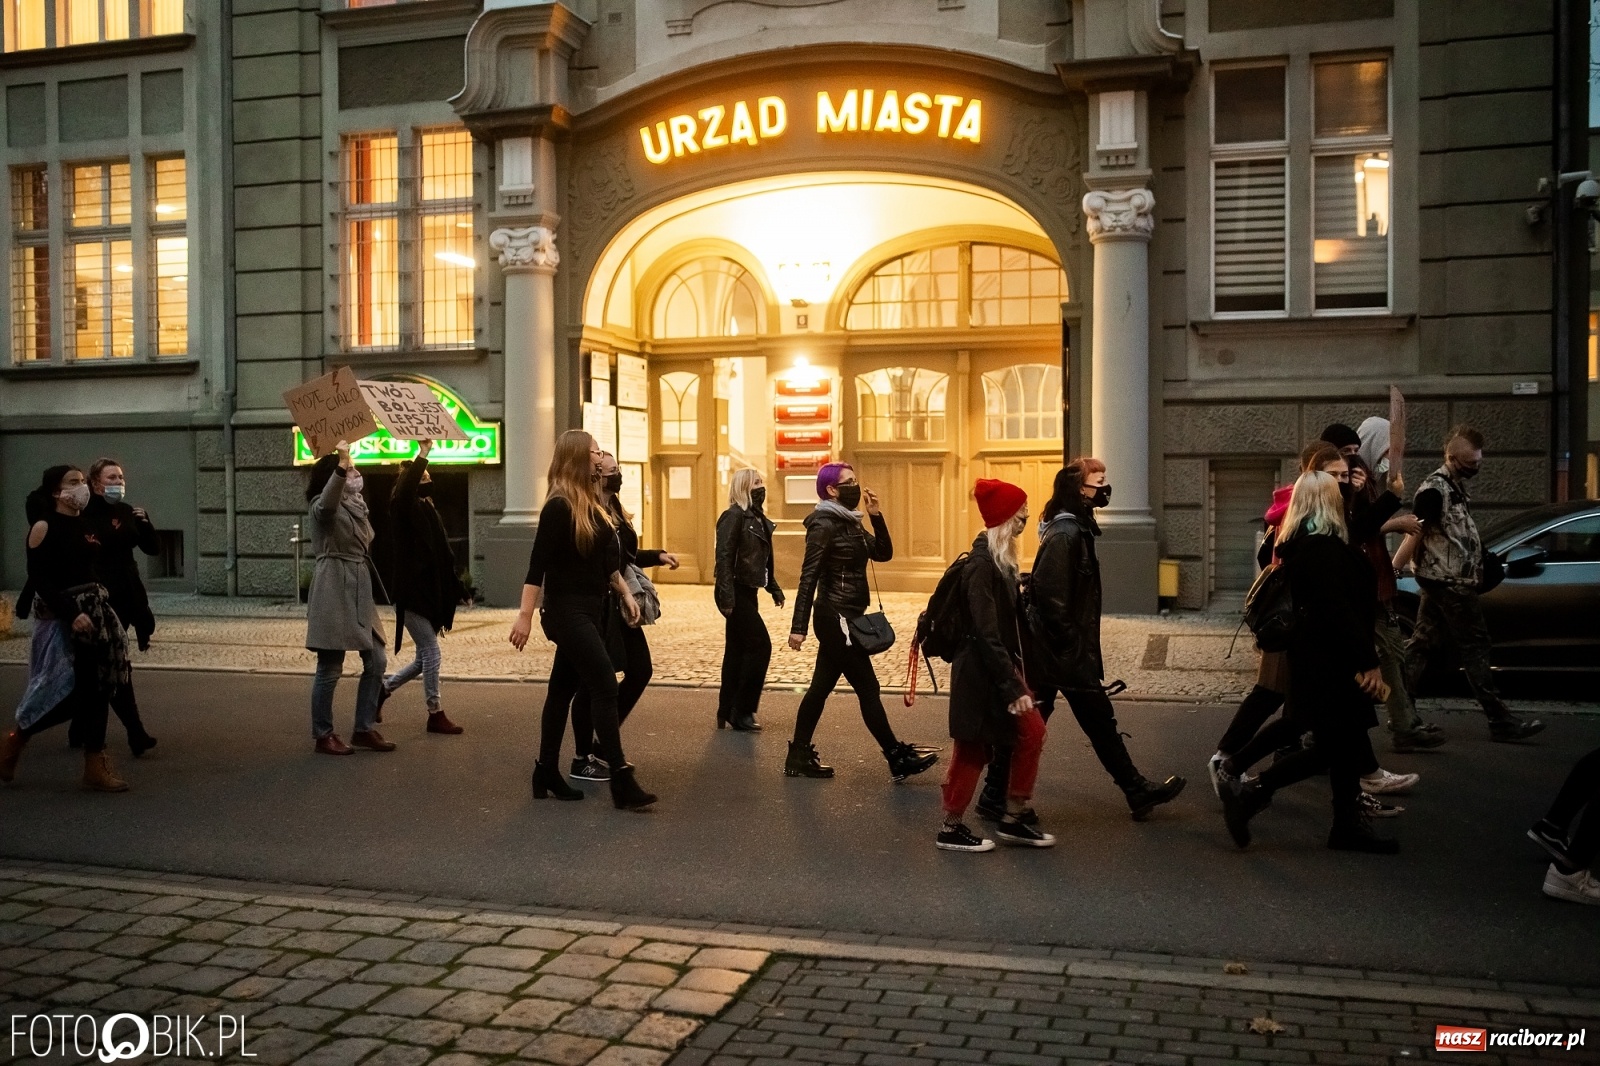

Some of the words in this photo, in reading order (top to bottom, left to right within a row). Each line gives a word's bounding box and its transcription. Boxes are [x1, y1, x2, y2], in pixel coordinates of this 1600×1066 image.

[816, 89, 982, 143] MIASTA
[359, 383, 416, 400] TWÓJ
[376, 398, 416, 413] BÓL
[414, 401, 445, 413] JEST
[387, 413, 440, 425] LEPSZY
